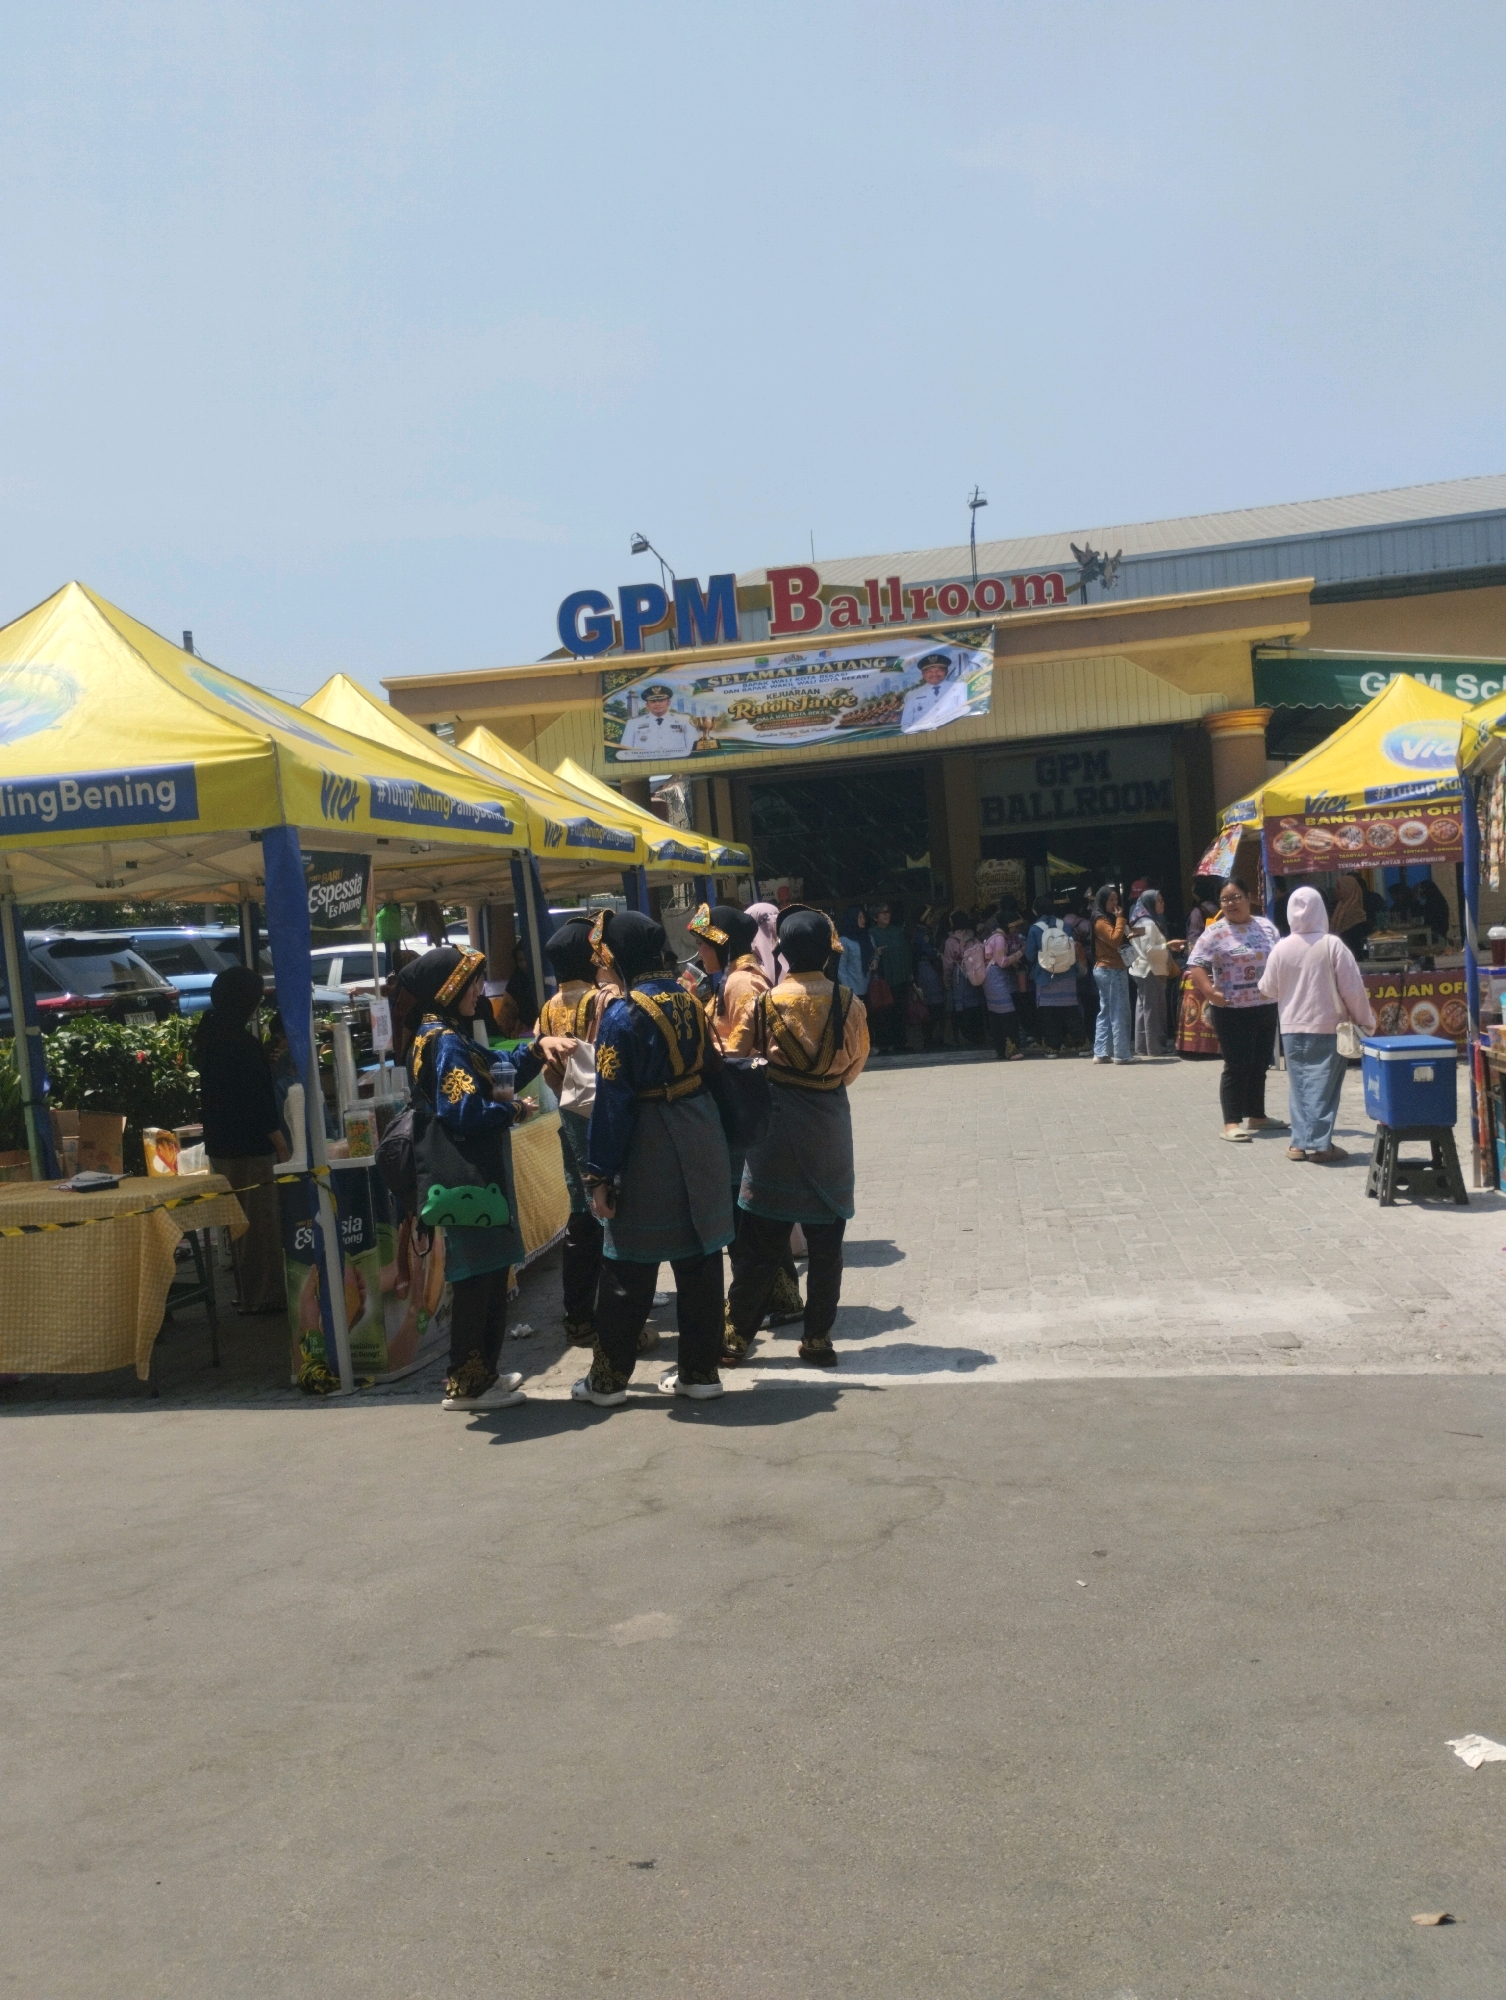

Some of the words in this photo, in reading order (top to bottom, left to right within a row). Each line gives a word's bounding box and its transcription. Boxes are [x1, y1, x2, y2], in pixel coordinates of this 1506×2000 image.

[557, 573, 741, 656] GPM
[766, 566, 1070, 637] Ballroom
[708, 668, 800, 688] SELAMAT
[806, 657, 888, 676] DATANG
[742, 681, 768, 689] BAPAK
[1360, 672, 1443, 698] GM
[1455, 674, 1506, 700] Sc
[766, 688, 821, 701] KEJUARAAN
[1035, 750, 1111, 787] GPM
[981, 778, 1172, 826] BALLROOM
[1305, 814, 1357, 826] BANG
[1361, 808, 1423, 822] JAJAN
[308, 873, 363, 914] Espessia
